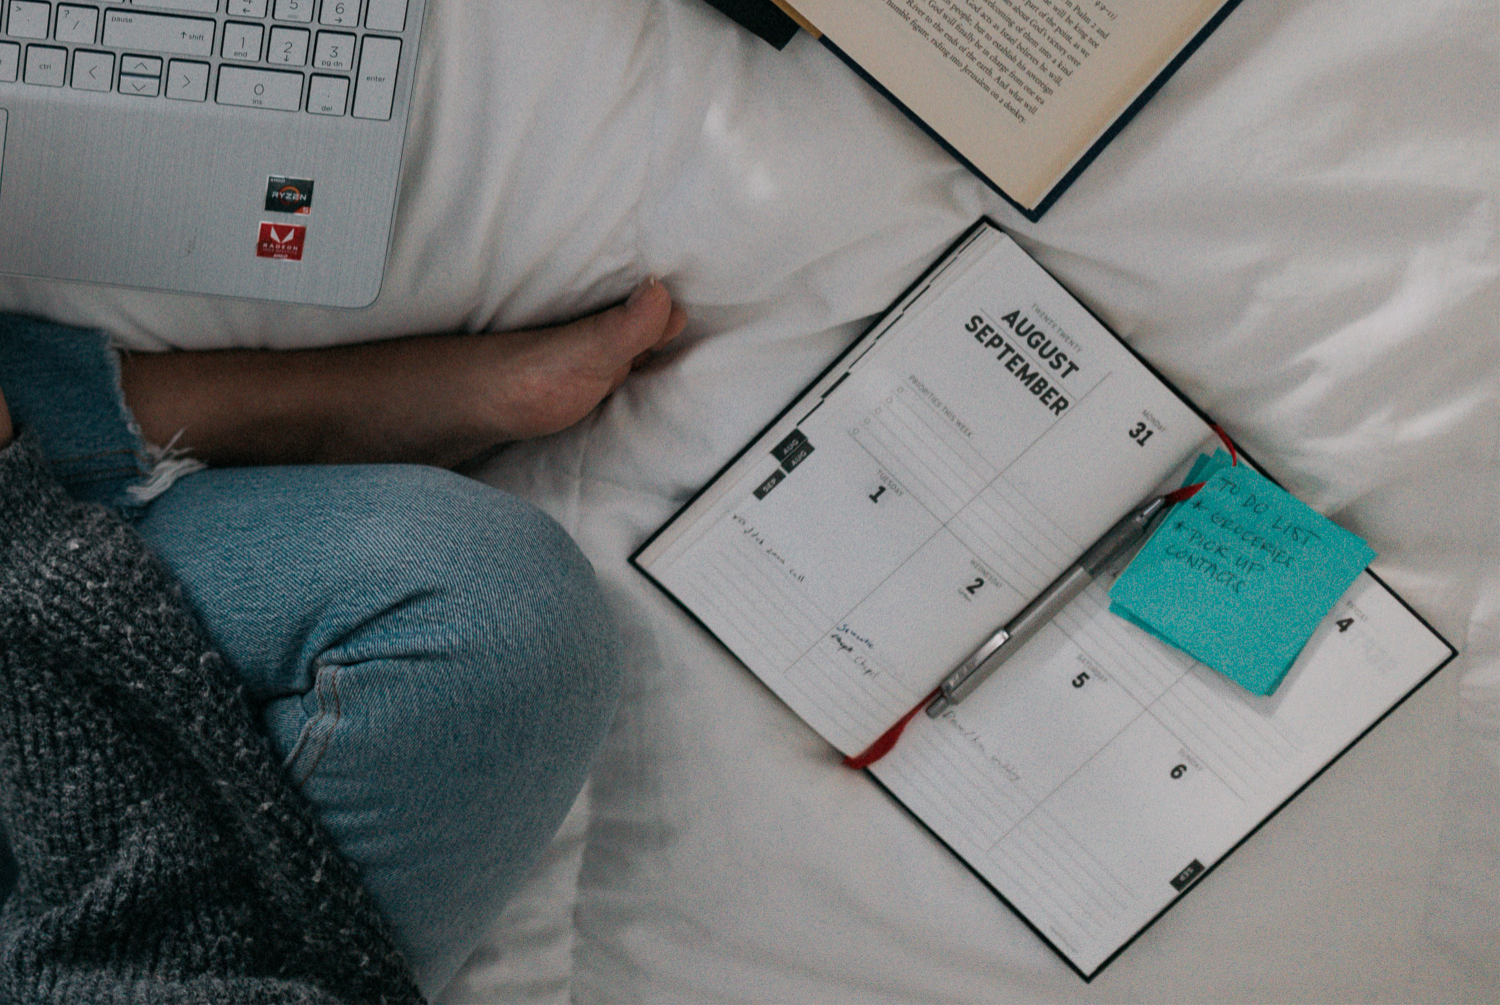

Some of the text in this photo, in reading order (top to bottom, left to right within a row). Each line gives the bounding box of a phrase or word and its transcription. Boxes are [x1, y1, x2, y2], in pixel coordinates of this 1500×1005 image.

[272, 191, 307, 201] RYZEN
[262, 243, 298, 251] RADEON
[1001, 310, 1079, 378] AUGUST
[965, 315, 1069, 416] SEPTEMBER
[1142, 410, 1166, 433] MONDAY
[1129, 422, 1153, 447] 31
[783, 439, 799, 455] AUG
[791, 450, 807, 466] AUG
[763, 478, 777, 493] SEP
[878, 469, 904, 496] TUESDAY
[869, 486, 886, 503] 1
[1221, 478, 1321, 548] TO DO LIST
[1211, 512, 1296, 568] GROCERIES
[1189, 528, 1265, 574] PICK UP
[1166, 544, 1246, 594] CONTACTS
[966, 578, 984, 595] 2
[1336, 618, 1354, 633] 4
[1072, 672, 1090, 688] 5
[1170, 764, 1187, 779] 6
